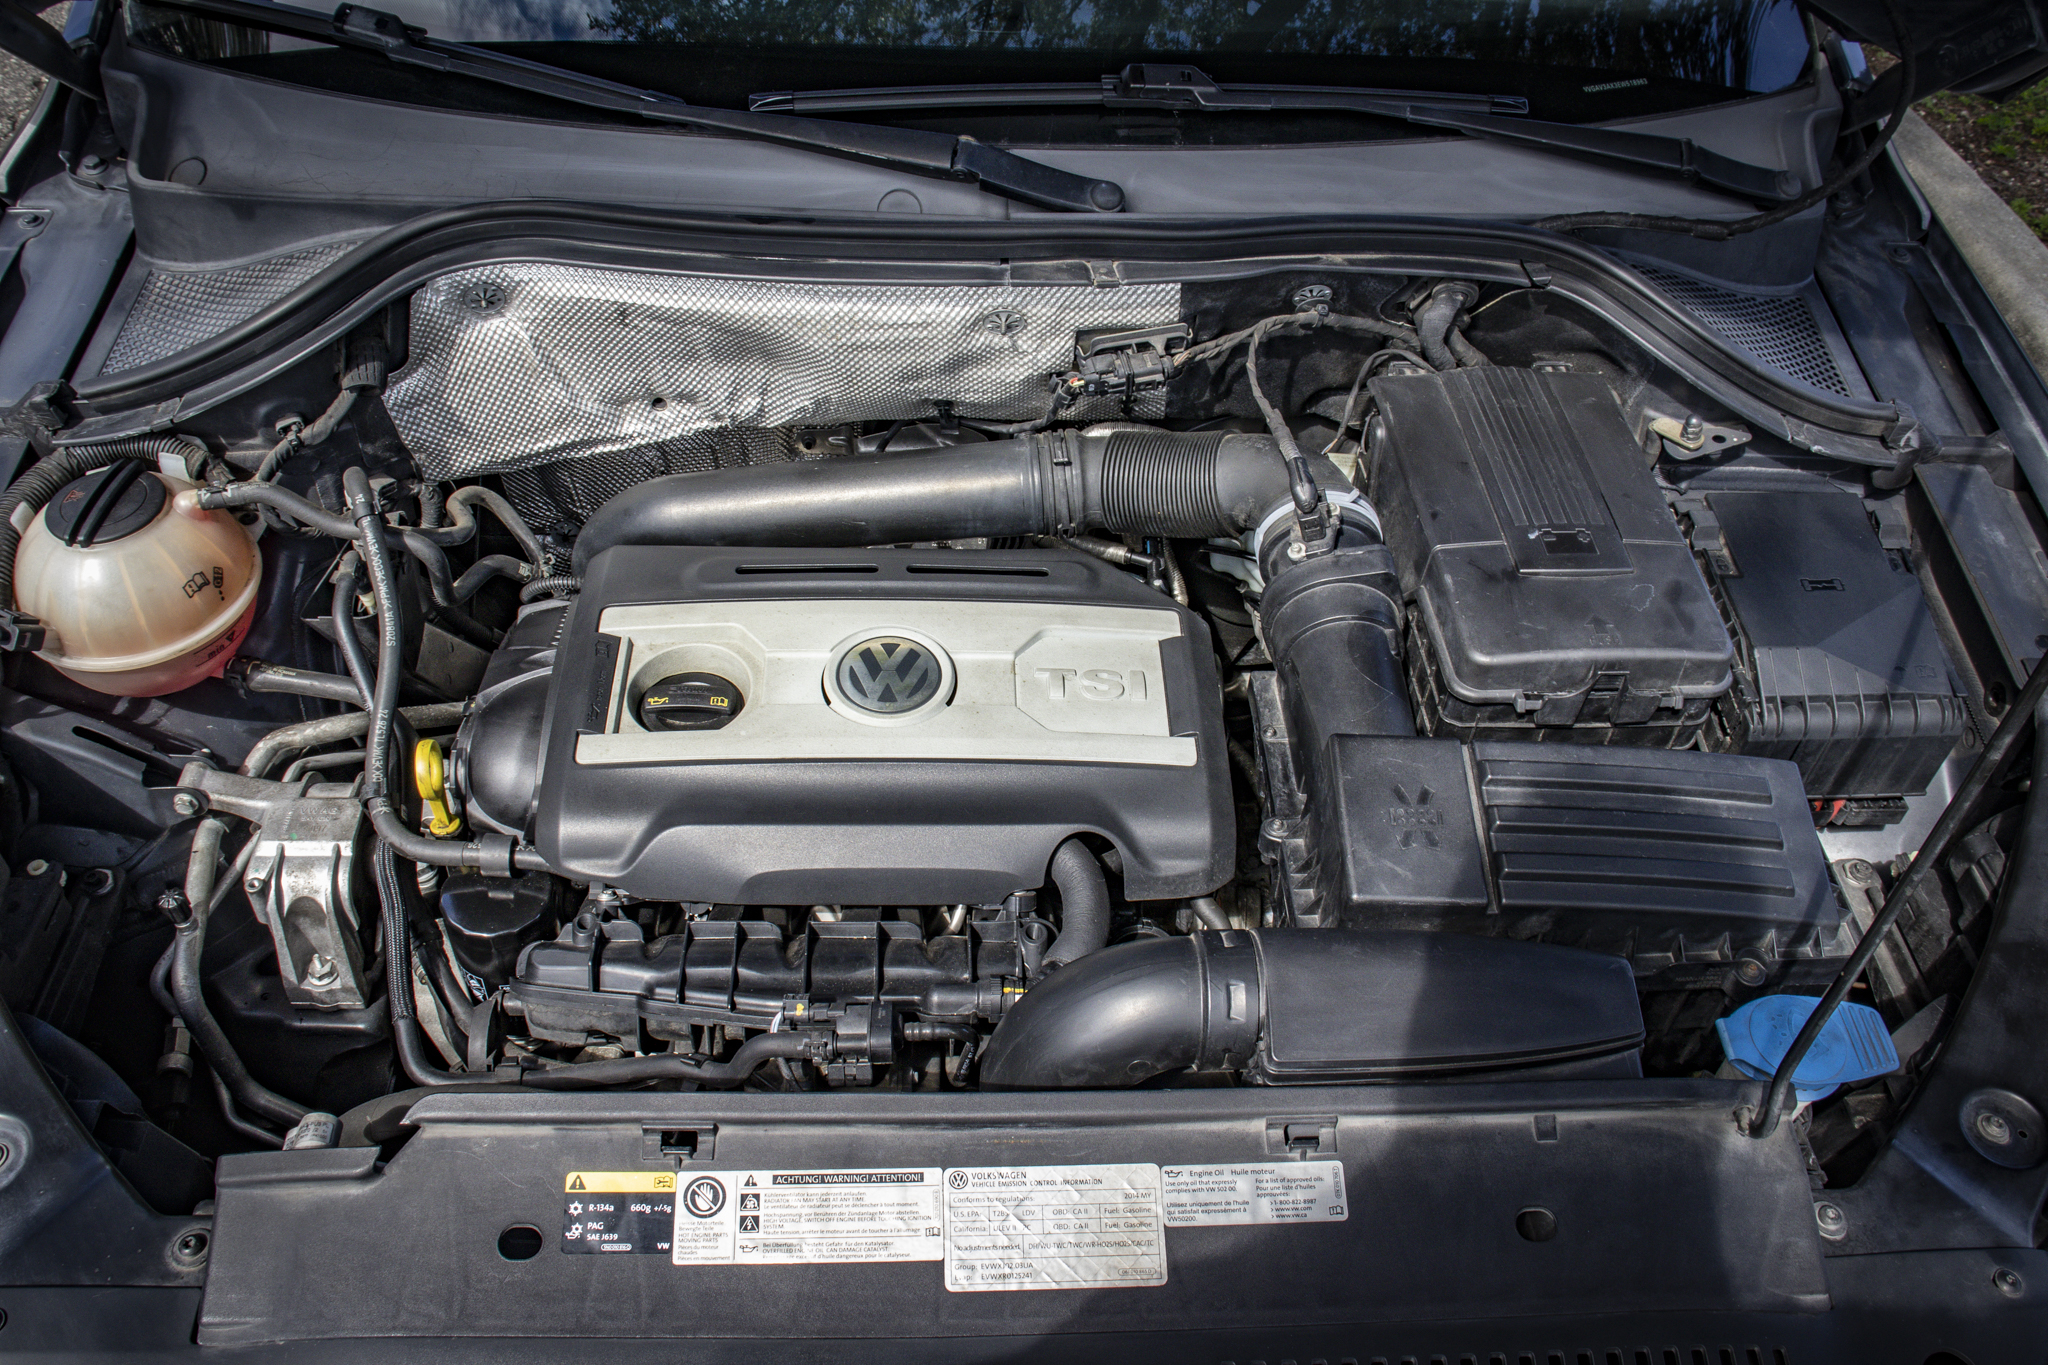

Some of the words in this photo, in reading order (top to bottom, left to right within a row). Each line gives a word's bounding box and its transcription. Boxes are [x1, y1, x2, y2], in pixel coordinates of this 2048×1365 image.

[208, 644, 225, 660] min
[1033, 666, 1147, 700] TSI
[776, 1174, 822, 1184] ACHTUNG!
[824, 1174, 870, 1184] WARNING!
[871, 1173, 922, 1183] ATTENTION!
[971, 1172, 1027, 1180] VOLKSWAGEN
[630, 1204, 651, 1213] 660g
[653, 1204, 672, 1214] +/-5g
